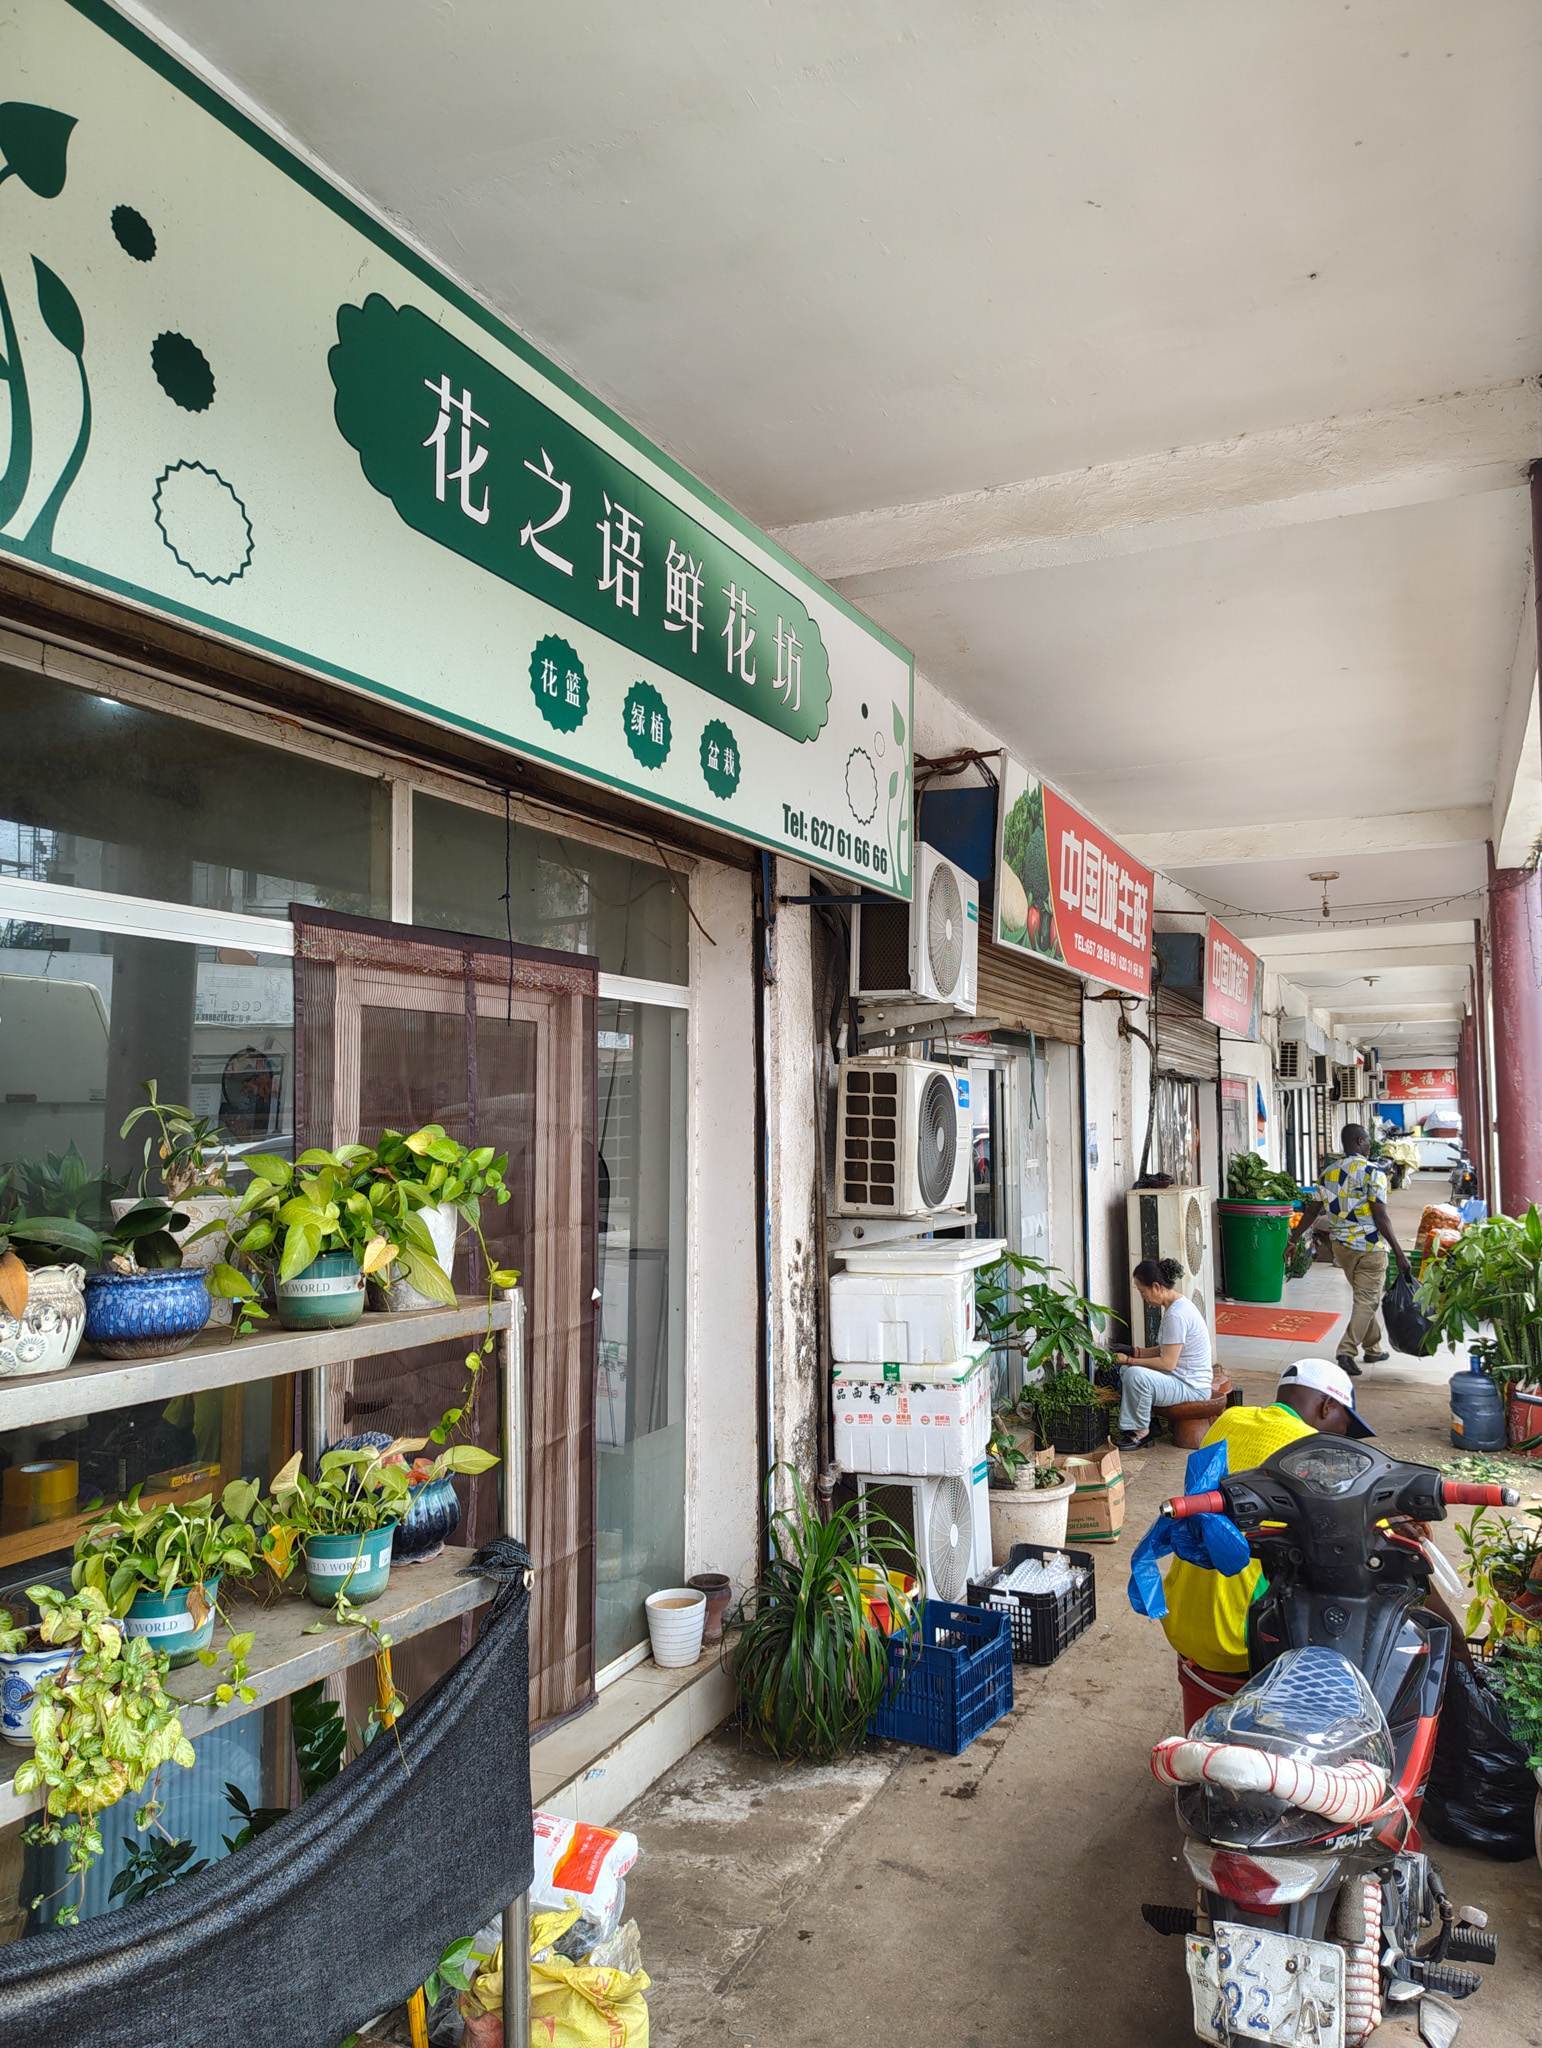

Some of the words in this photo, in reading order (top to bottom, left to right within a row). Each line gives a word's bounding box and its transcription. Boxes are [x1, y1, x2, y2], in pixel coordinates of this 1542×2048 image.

[421, 373, 805, 712] 花之语鲜花坊
[539, 658, 582, 709] 花篮
[630, 701, 665, 746] 绿植
[707, 739, 736, 777] 盆栽
[782, 803, 808, 842] Tel:
[811, 816, 835, 852] 627
[837, 828, 851, 860] 61
[854, 836, 870, 868] 66
[873, 844, 888, 875] 66
[1059, 829, 1149, 952] 中国城生鲜
[290, 1282, 331, 1294] WORLD
[134, 1620, 179, 1633] WORLD
